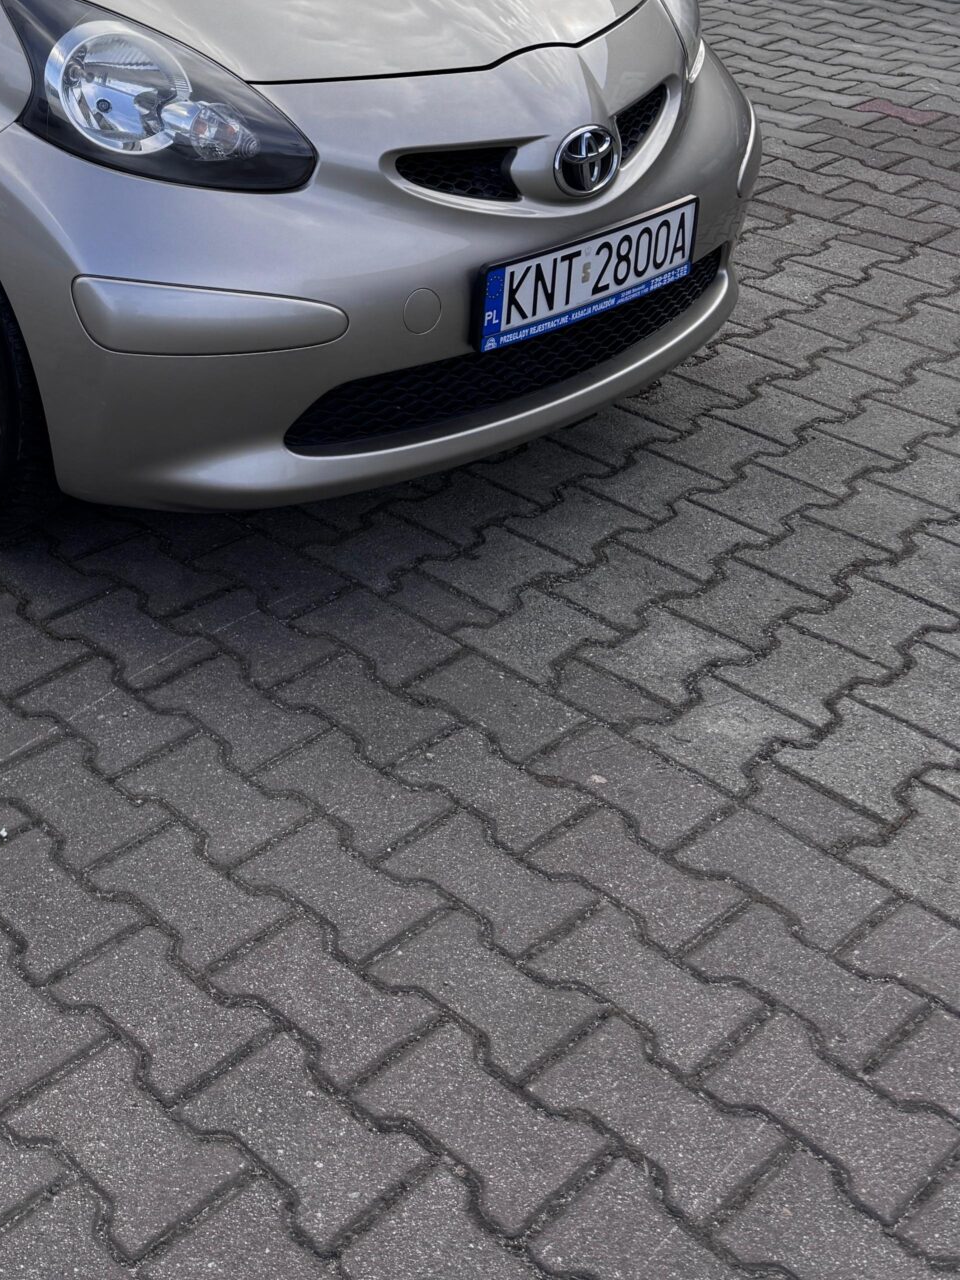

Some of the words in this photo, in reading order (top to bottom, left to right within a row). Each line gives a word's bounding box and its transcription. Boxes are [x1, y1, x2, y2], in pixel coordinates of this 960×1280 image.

[506, 250, 581, 325] KNT
[591, 212, 686, 296] 2800A
[484, 310, 499, 326] PL
[500, 328, 529, 344] PRZEGLĄDY
[529, 316, 569, 335] REJESTRACYJNE
